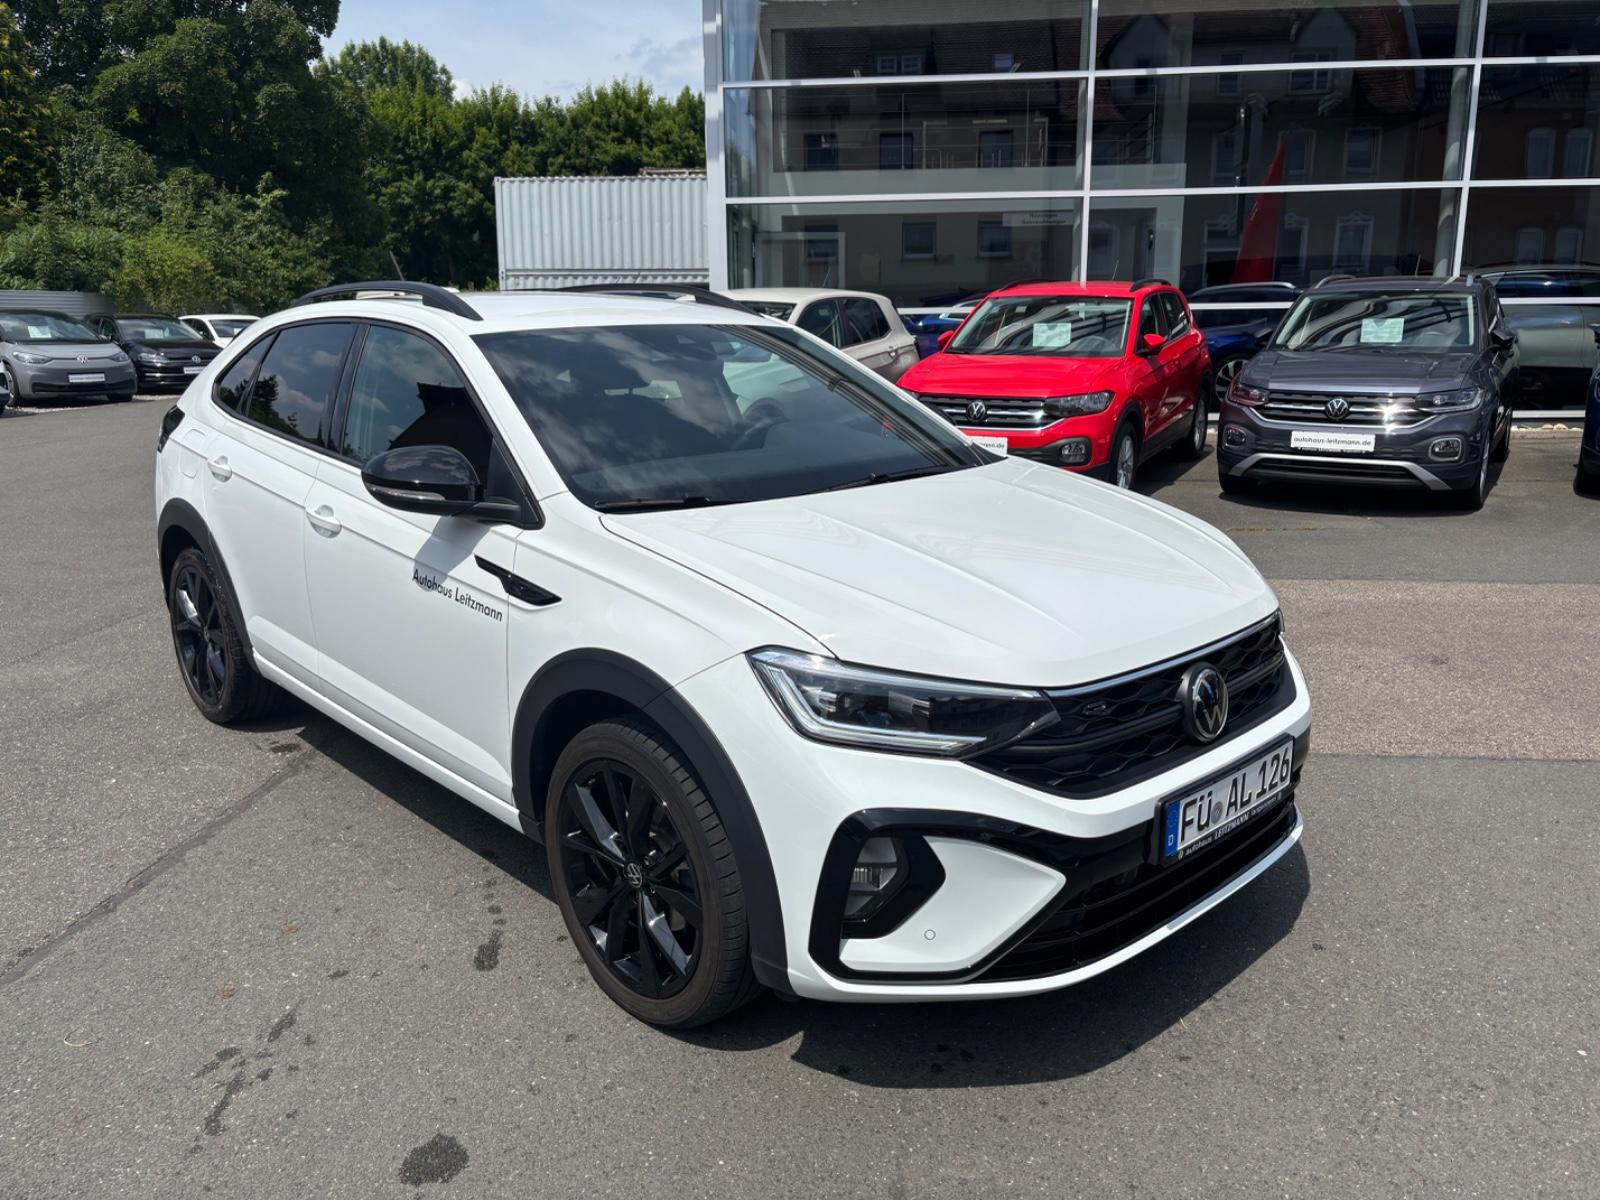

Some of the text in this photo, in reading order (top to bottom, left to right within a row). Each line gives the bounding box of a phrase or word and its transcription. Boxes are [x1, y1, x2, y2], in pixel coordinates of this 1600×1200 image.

[1327, 398, 1348, 420] VW
[412, 568, 503, 622] Autohaus Leitzmann
[1180, 747, 1291, 842] FÜ AL 126
[1168, 834, 1174, 846] D
